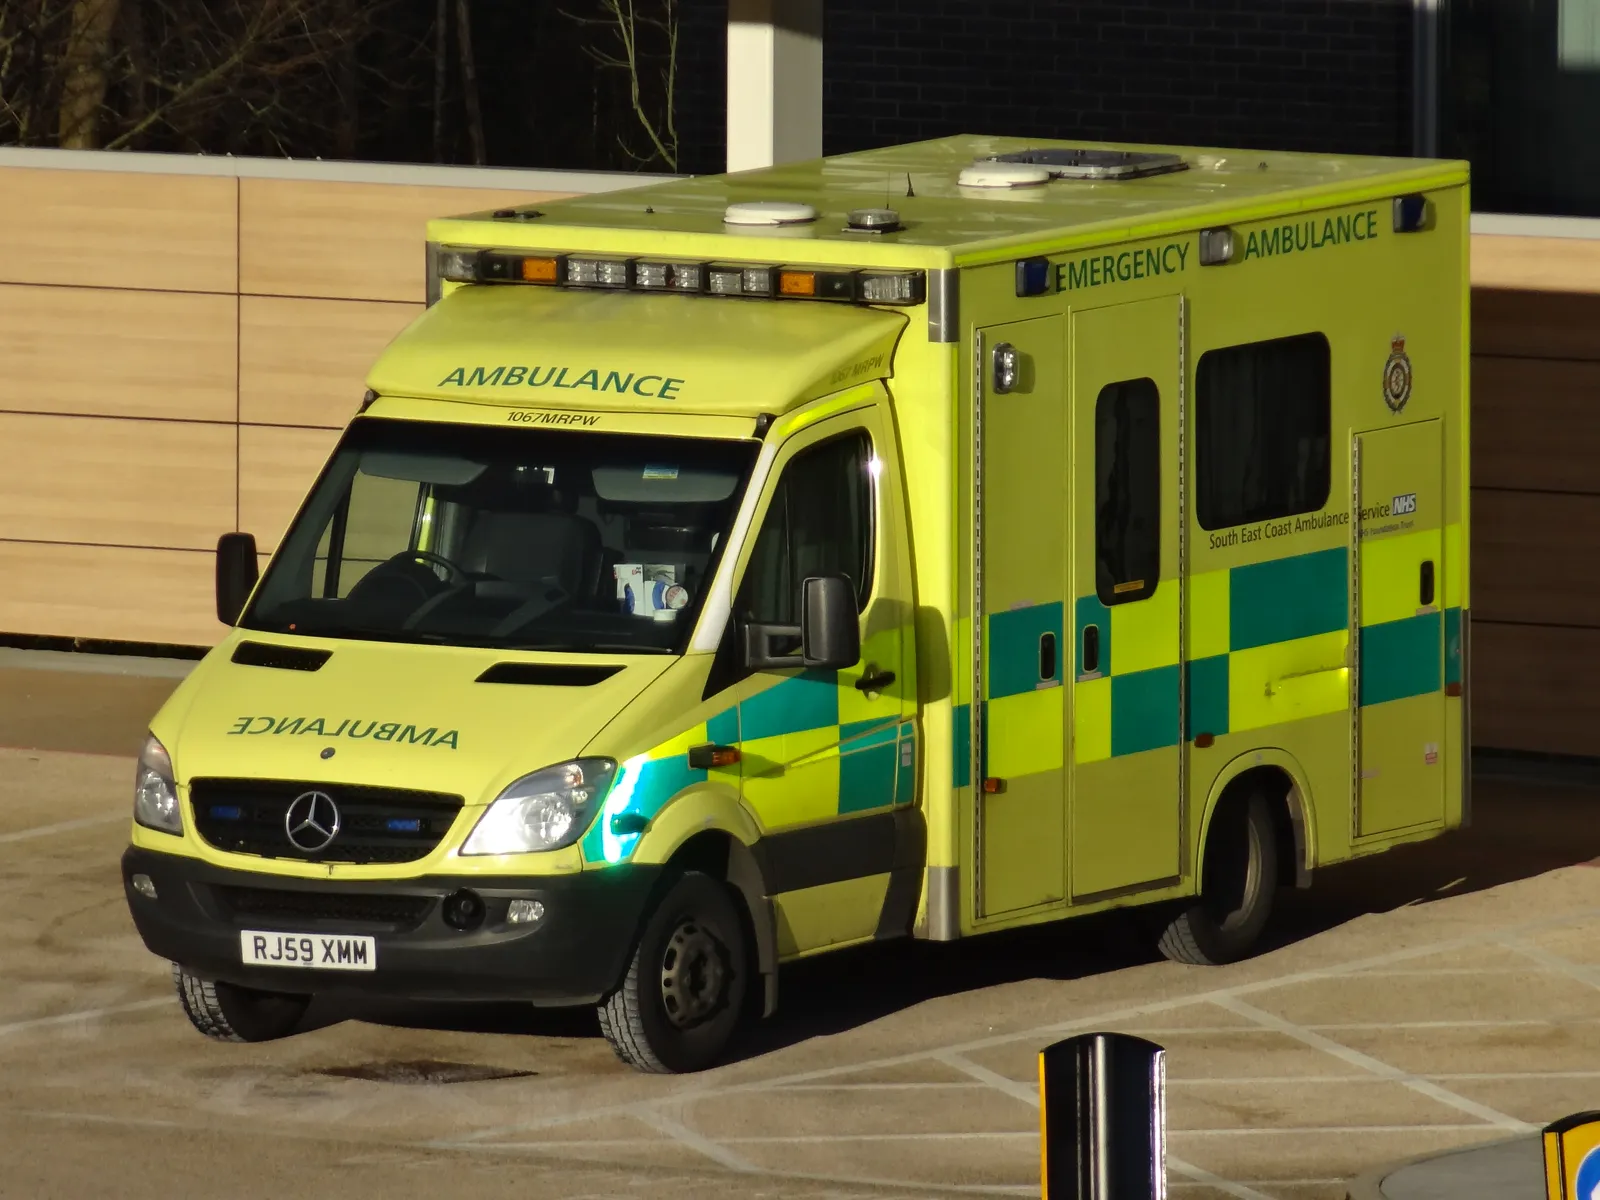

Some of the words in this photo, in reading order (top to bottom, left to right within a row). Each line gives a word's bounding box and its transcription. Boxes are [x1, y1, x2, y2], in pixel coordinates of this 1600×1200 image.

[1055, 242, 1190, 292] EMERGENCY
[1244, 210, 1378, 260] AMBULANCE
[437, 366, 686, 400] AMBULANCE
[506, 411, 601, 426] 1067MRPW
[1393, 494, 1416, 515] NHS
[1209, 530, 1238, 550] South
[1241, 527, 1262, 544] East
[1264, 520, 1292, 539] Coast
[1294, 512, 1350, 533] Ambulance
[253, 935, 314, 962] RJ59
[321, 938, 367, 965] XMM
